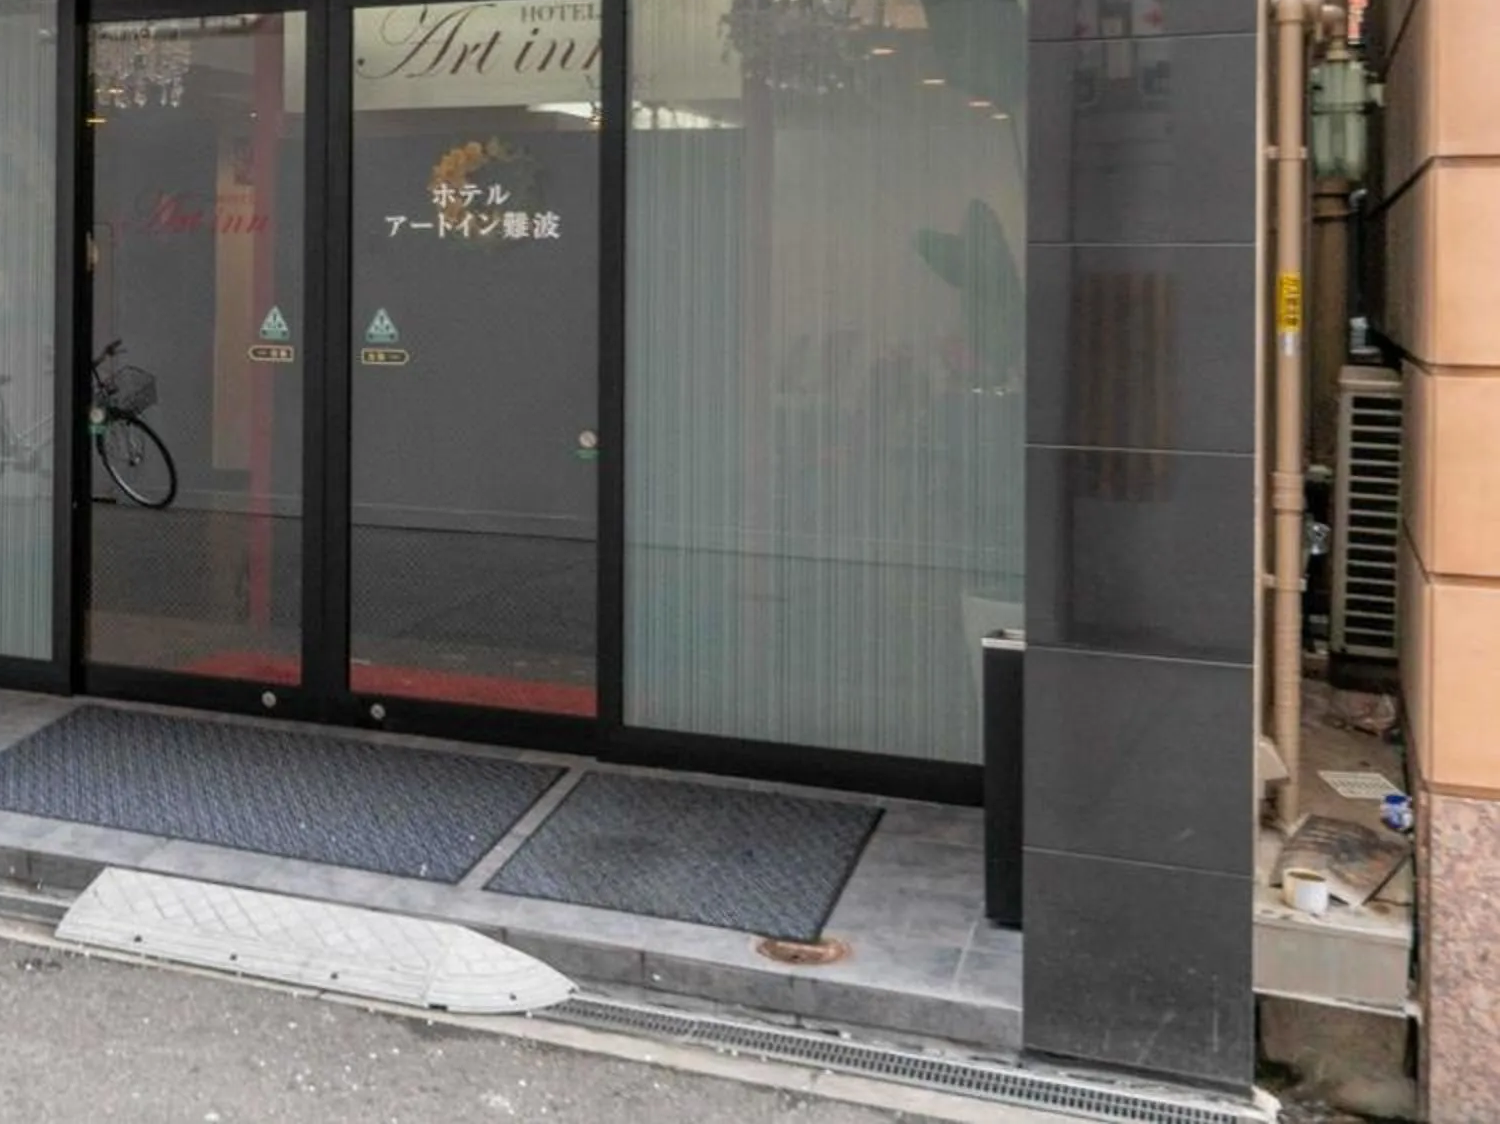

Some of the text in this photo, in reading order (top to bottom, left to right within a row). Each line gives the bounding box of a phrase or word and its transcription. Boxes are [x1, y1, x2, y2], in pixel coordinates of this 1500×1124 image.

[355, 4, 501, 80] Art
[432, 183, 512, 208] ホテル
[384, 211, 562, 239] アートイン難波
